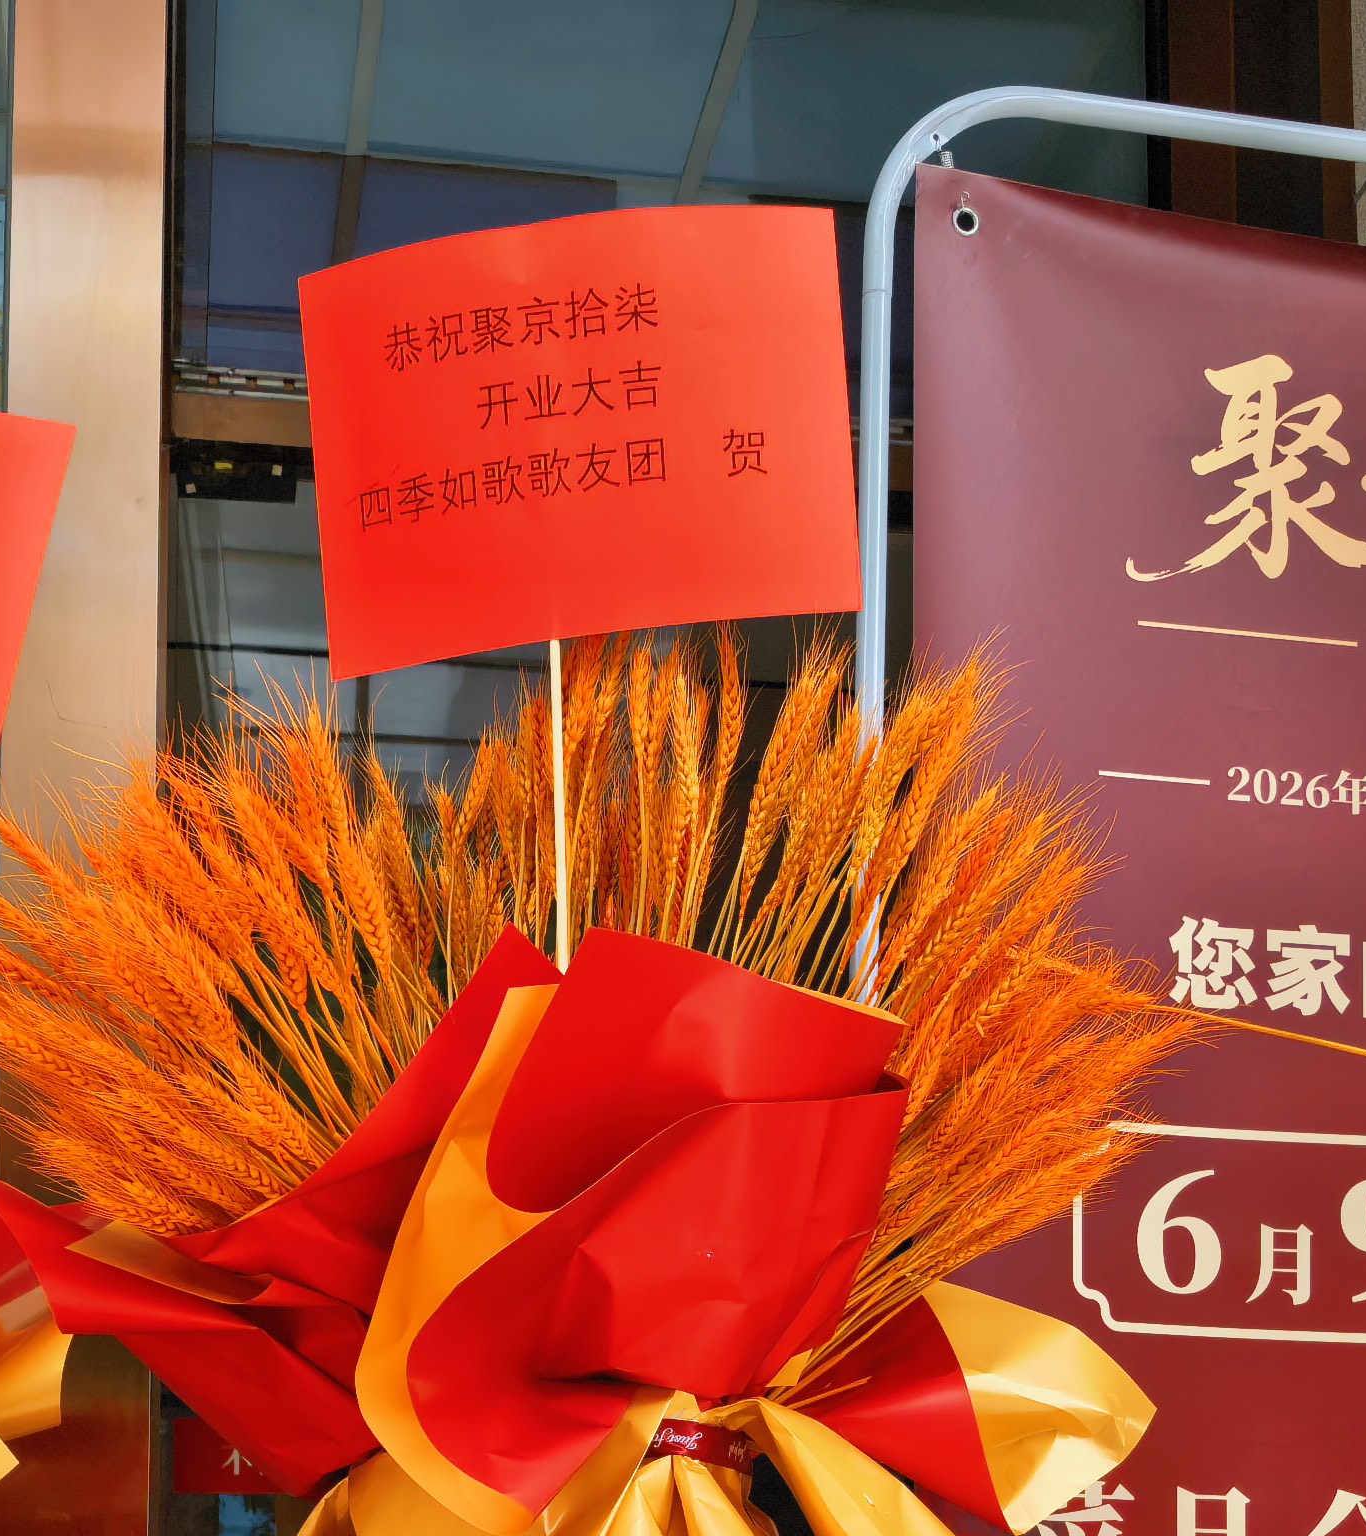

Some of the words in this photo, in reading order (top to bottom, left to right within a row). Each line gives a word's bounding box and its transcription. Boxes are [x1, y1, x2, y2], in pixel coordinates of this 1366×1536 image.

[383, 282, 659, 372] 恭祝聚京拾柒
[477, 361, 662, 429] 开业大吉
[360, 438, 666, 531] 四季如歌歌友团
[723, 429, 767, 477] 贺
